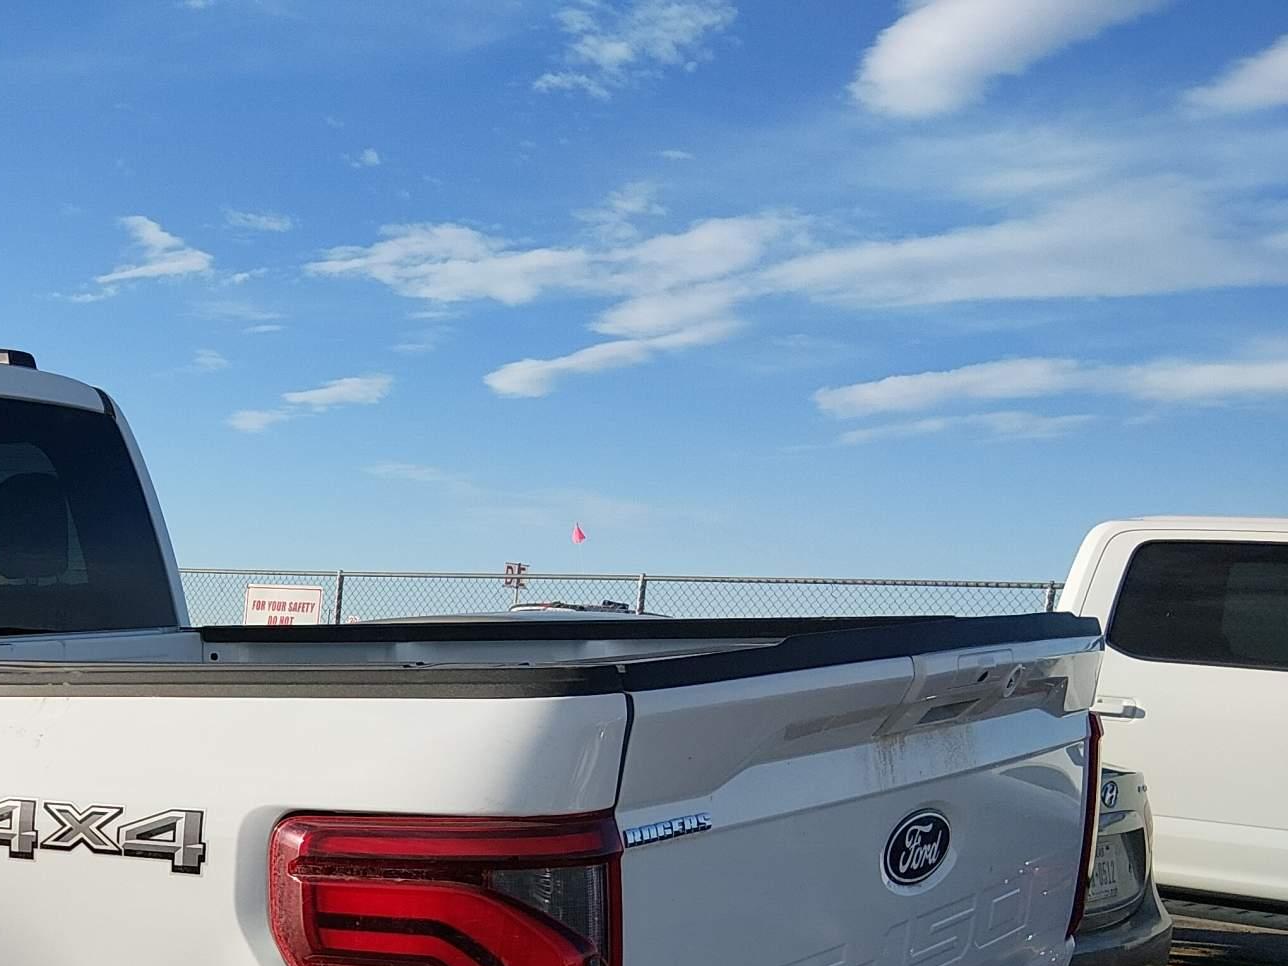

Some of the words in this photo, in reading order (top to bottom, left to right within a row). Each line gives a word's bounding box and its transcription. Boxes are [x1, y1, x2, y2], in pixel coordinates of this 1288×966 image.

[252, 600, 266, 611] FOR
[268, 601, 286, 612] YOUR
[288, 602, 316, 613] SAFETY
[267, 615, 277, 625] DO
[279, 616, 295, 625] NOT
[898, 822, 943, 875] Ford
